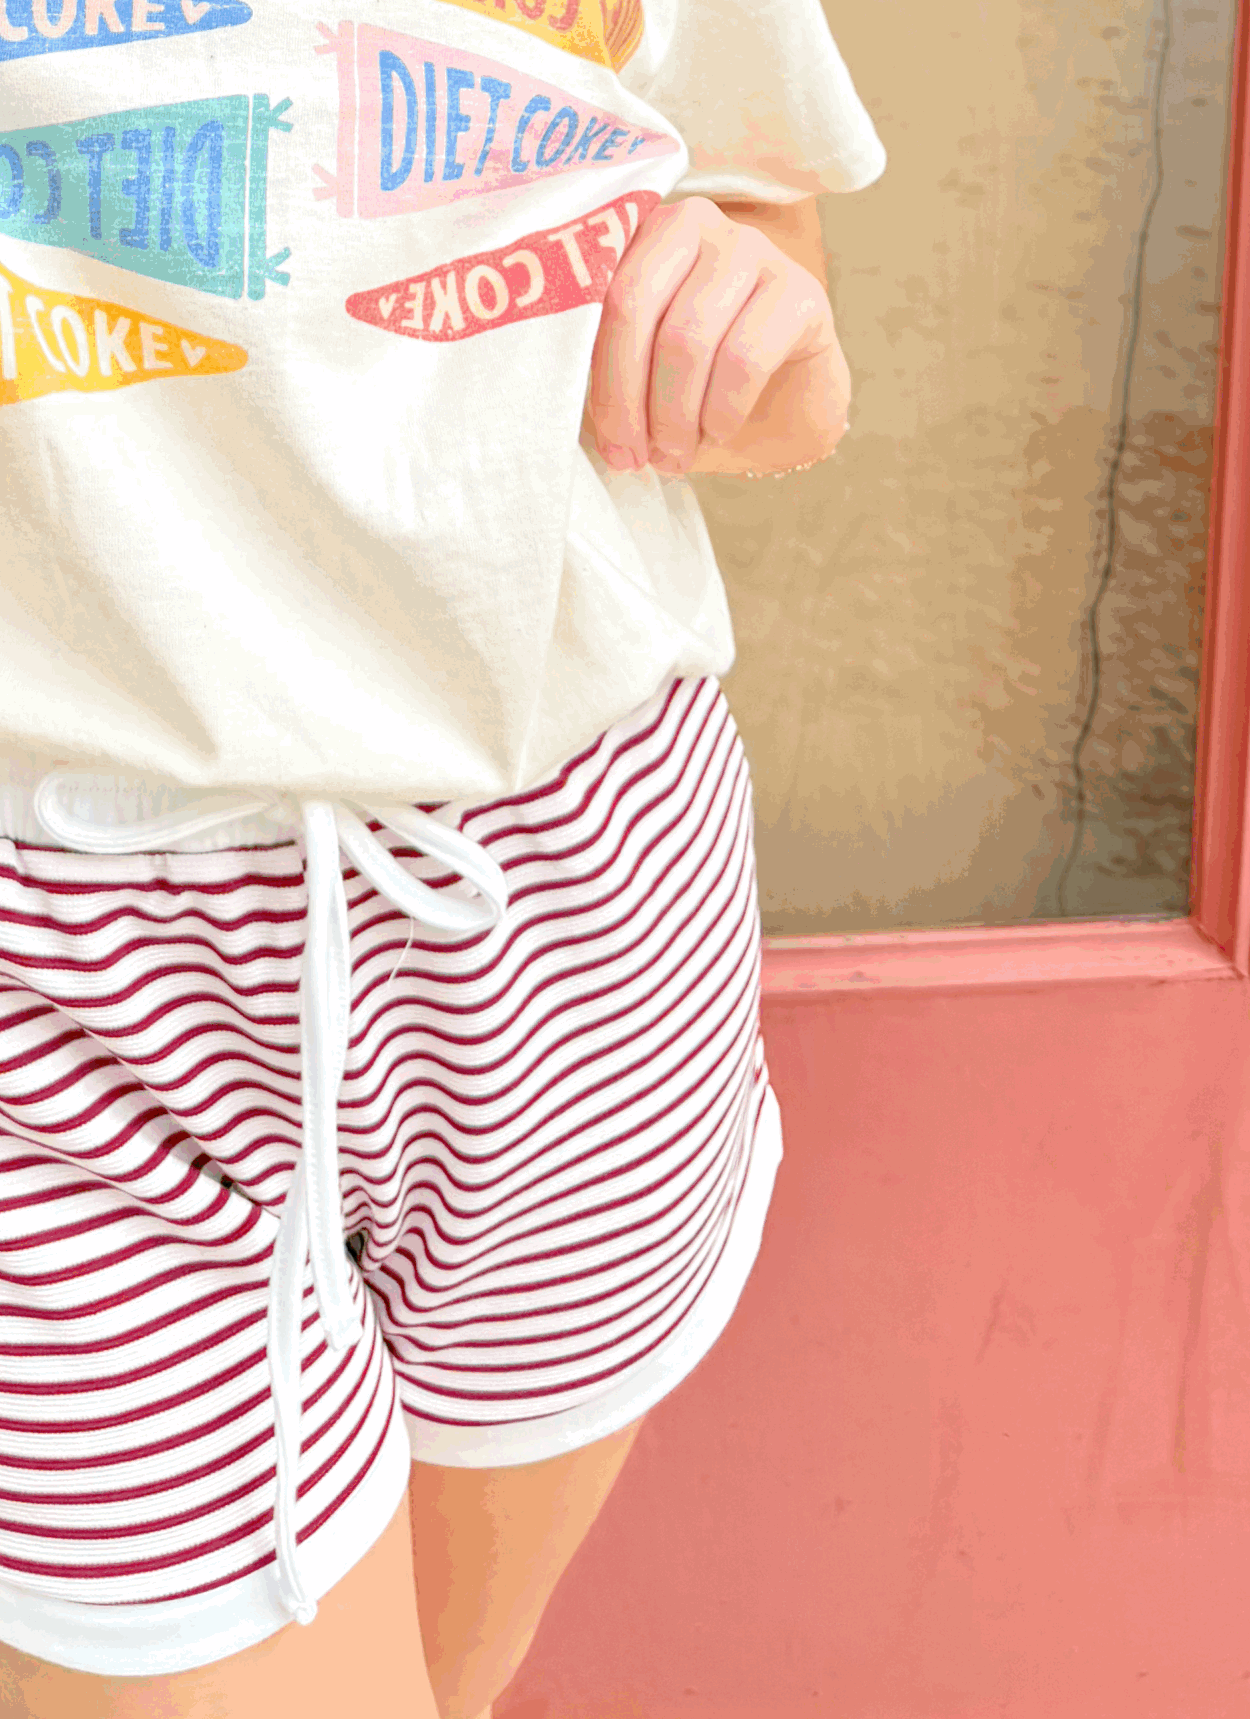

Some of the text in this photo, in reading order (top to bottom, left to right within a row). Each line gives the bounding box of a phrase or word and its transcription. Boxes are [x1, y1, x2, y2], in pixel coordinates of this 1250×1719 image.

[379, 49, 630, 192] DIET COKE
[26, 294, 173, 378] COKE
